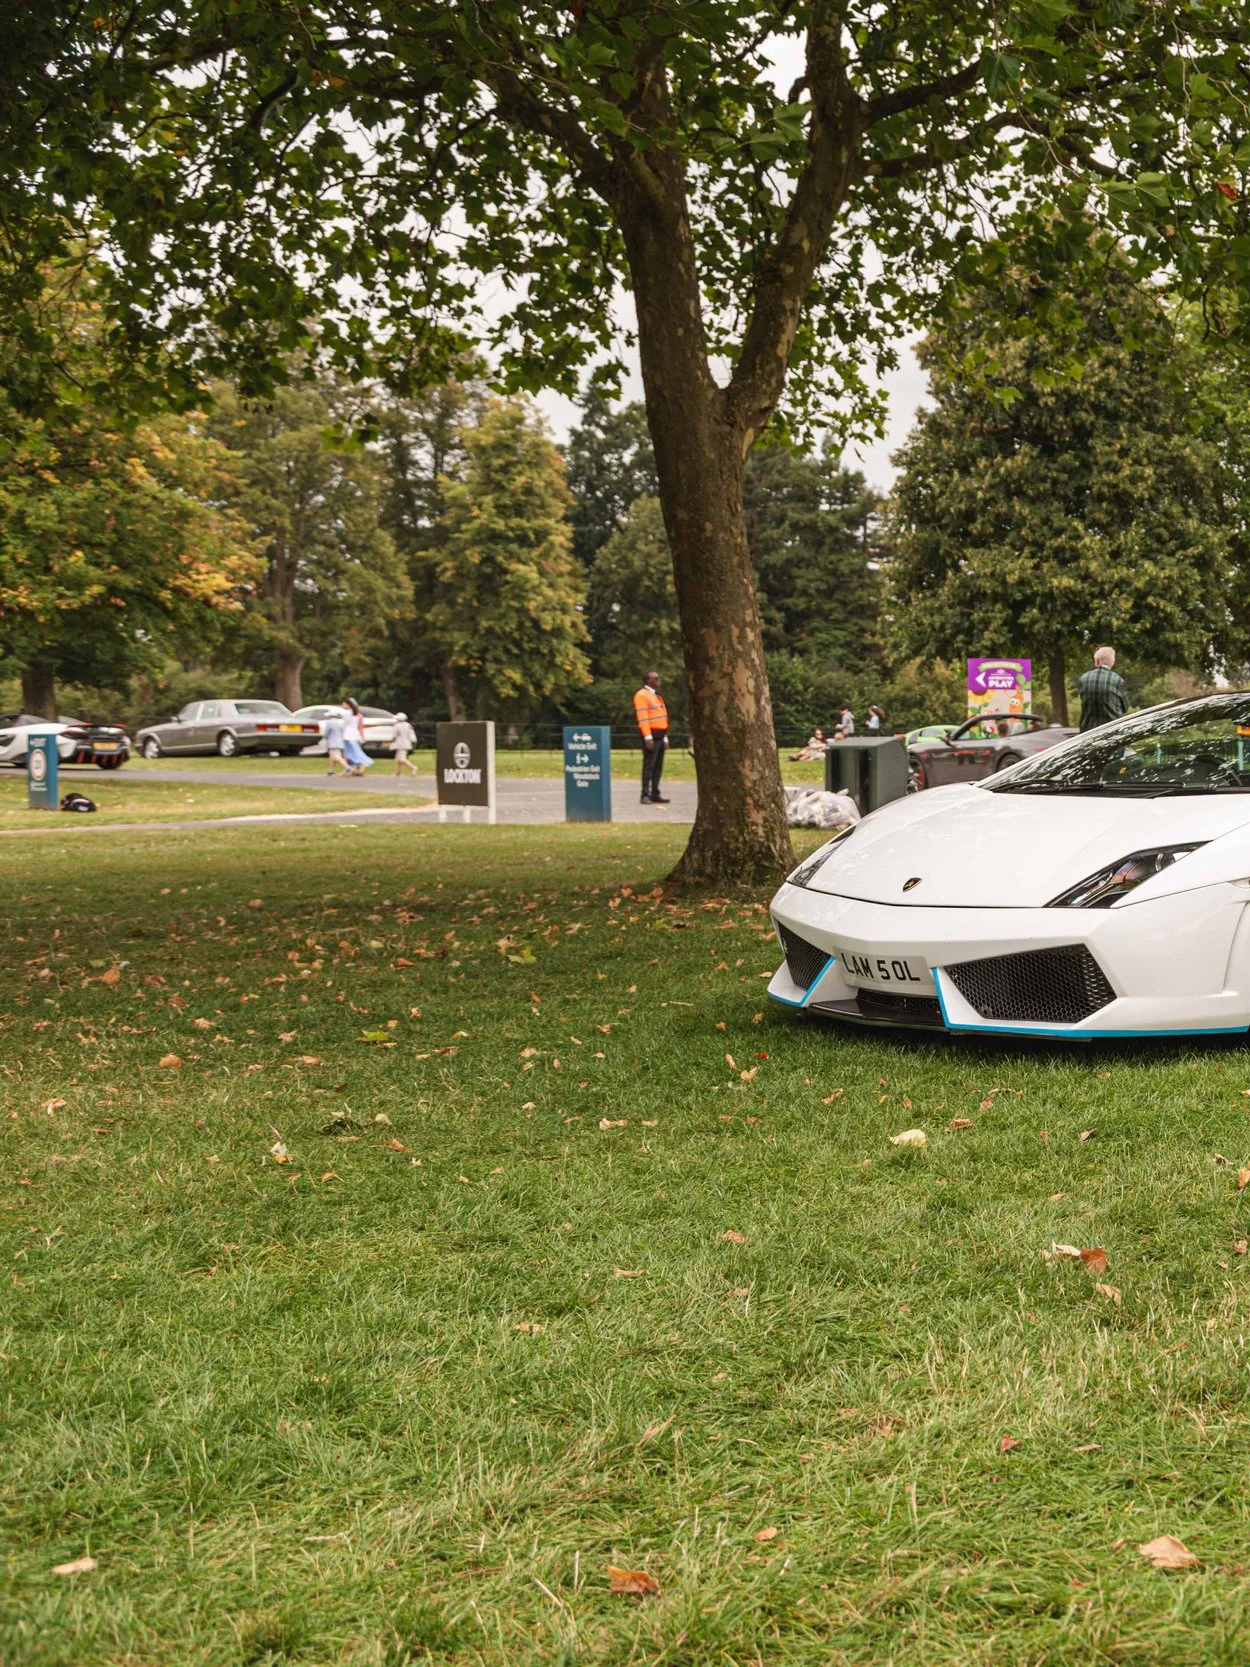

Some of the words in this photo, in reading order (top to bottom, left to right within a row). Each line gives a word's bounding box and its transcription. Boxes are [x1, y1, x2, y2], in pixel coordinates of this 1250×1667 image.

[988, 680, 1014, 688] PLAY
[444, 768, 481, 784] LOCKTON
[841, 953, 874, 979] LAM
